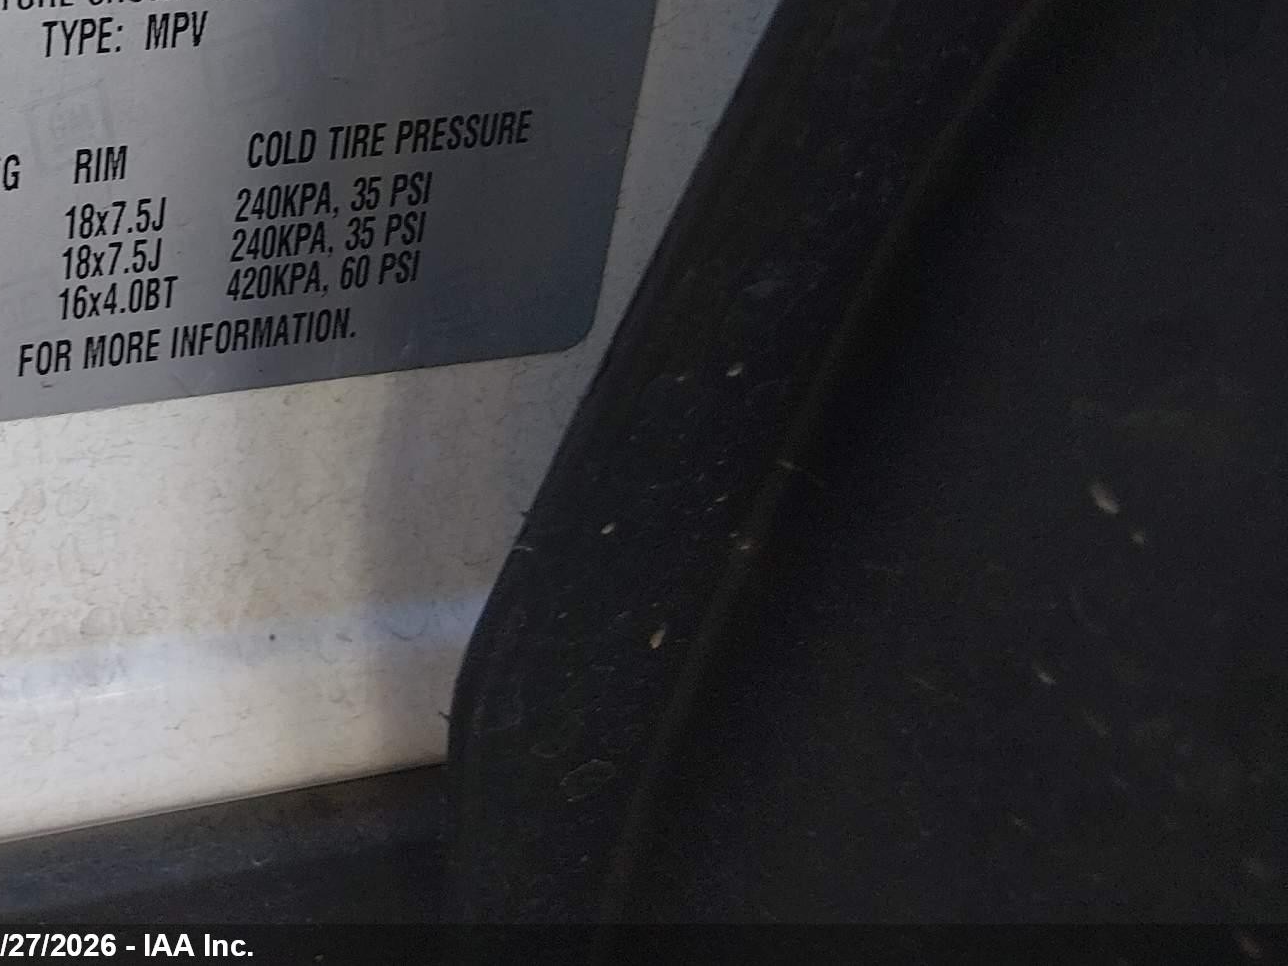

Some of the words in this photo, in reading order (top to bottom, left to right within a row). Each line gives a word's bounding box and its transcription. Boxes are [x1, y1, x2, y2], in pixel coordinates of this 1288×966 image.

[43, 17, 122, 57] TYPE:
[146, 11, 208, 50] MPV
[248, 129, 316, 168] COLD
[329, 123, 387, 160] TIRE
[395, 110, 532, 154] PRESSURE
[74, 146, 127, 184] RIM
[66, 197, 166, 239] 18x7.5J
[235, 181, 339, 222] 240KPA,
[351, 177, 381, 211] 35
[390, 172, 432, 207] PSI
[63, 238, 162, 279] 18x7.5J
[231, 221, 333, 262] 240KPA,
[346, 216, 376, 250] 35
[384, 211, 426, 246] PSI
[59, 276, 178, 320] 16x4.0BT
[227, 261, 328, 301] 420KPA,
[340, 255, 370, 289] 60
[379, 250, 420, 284] PSI
[19, 340, 71, 376] FOR
[84, 329, 160, 369] MORE
[171, 307, 356, 358] INFORMATION.
